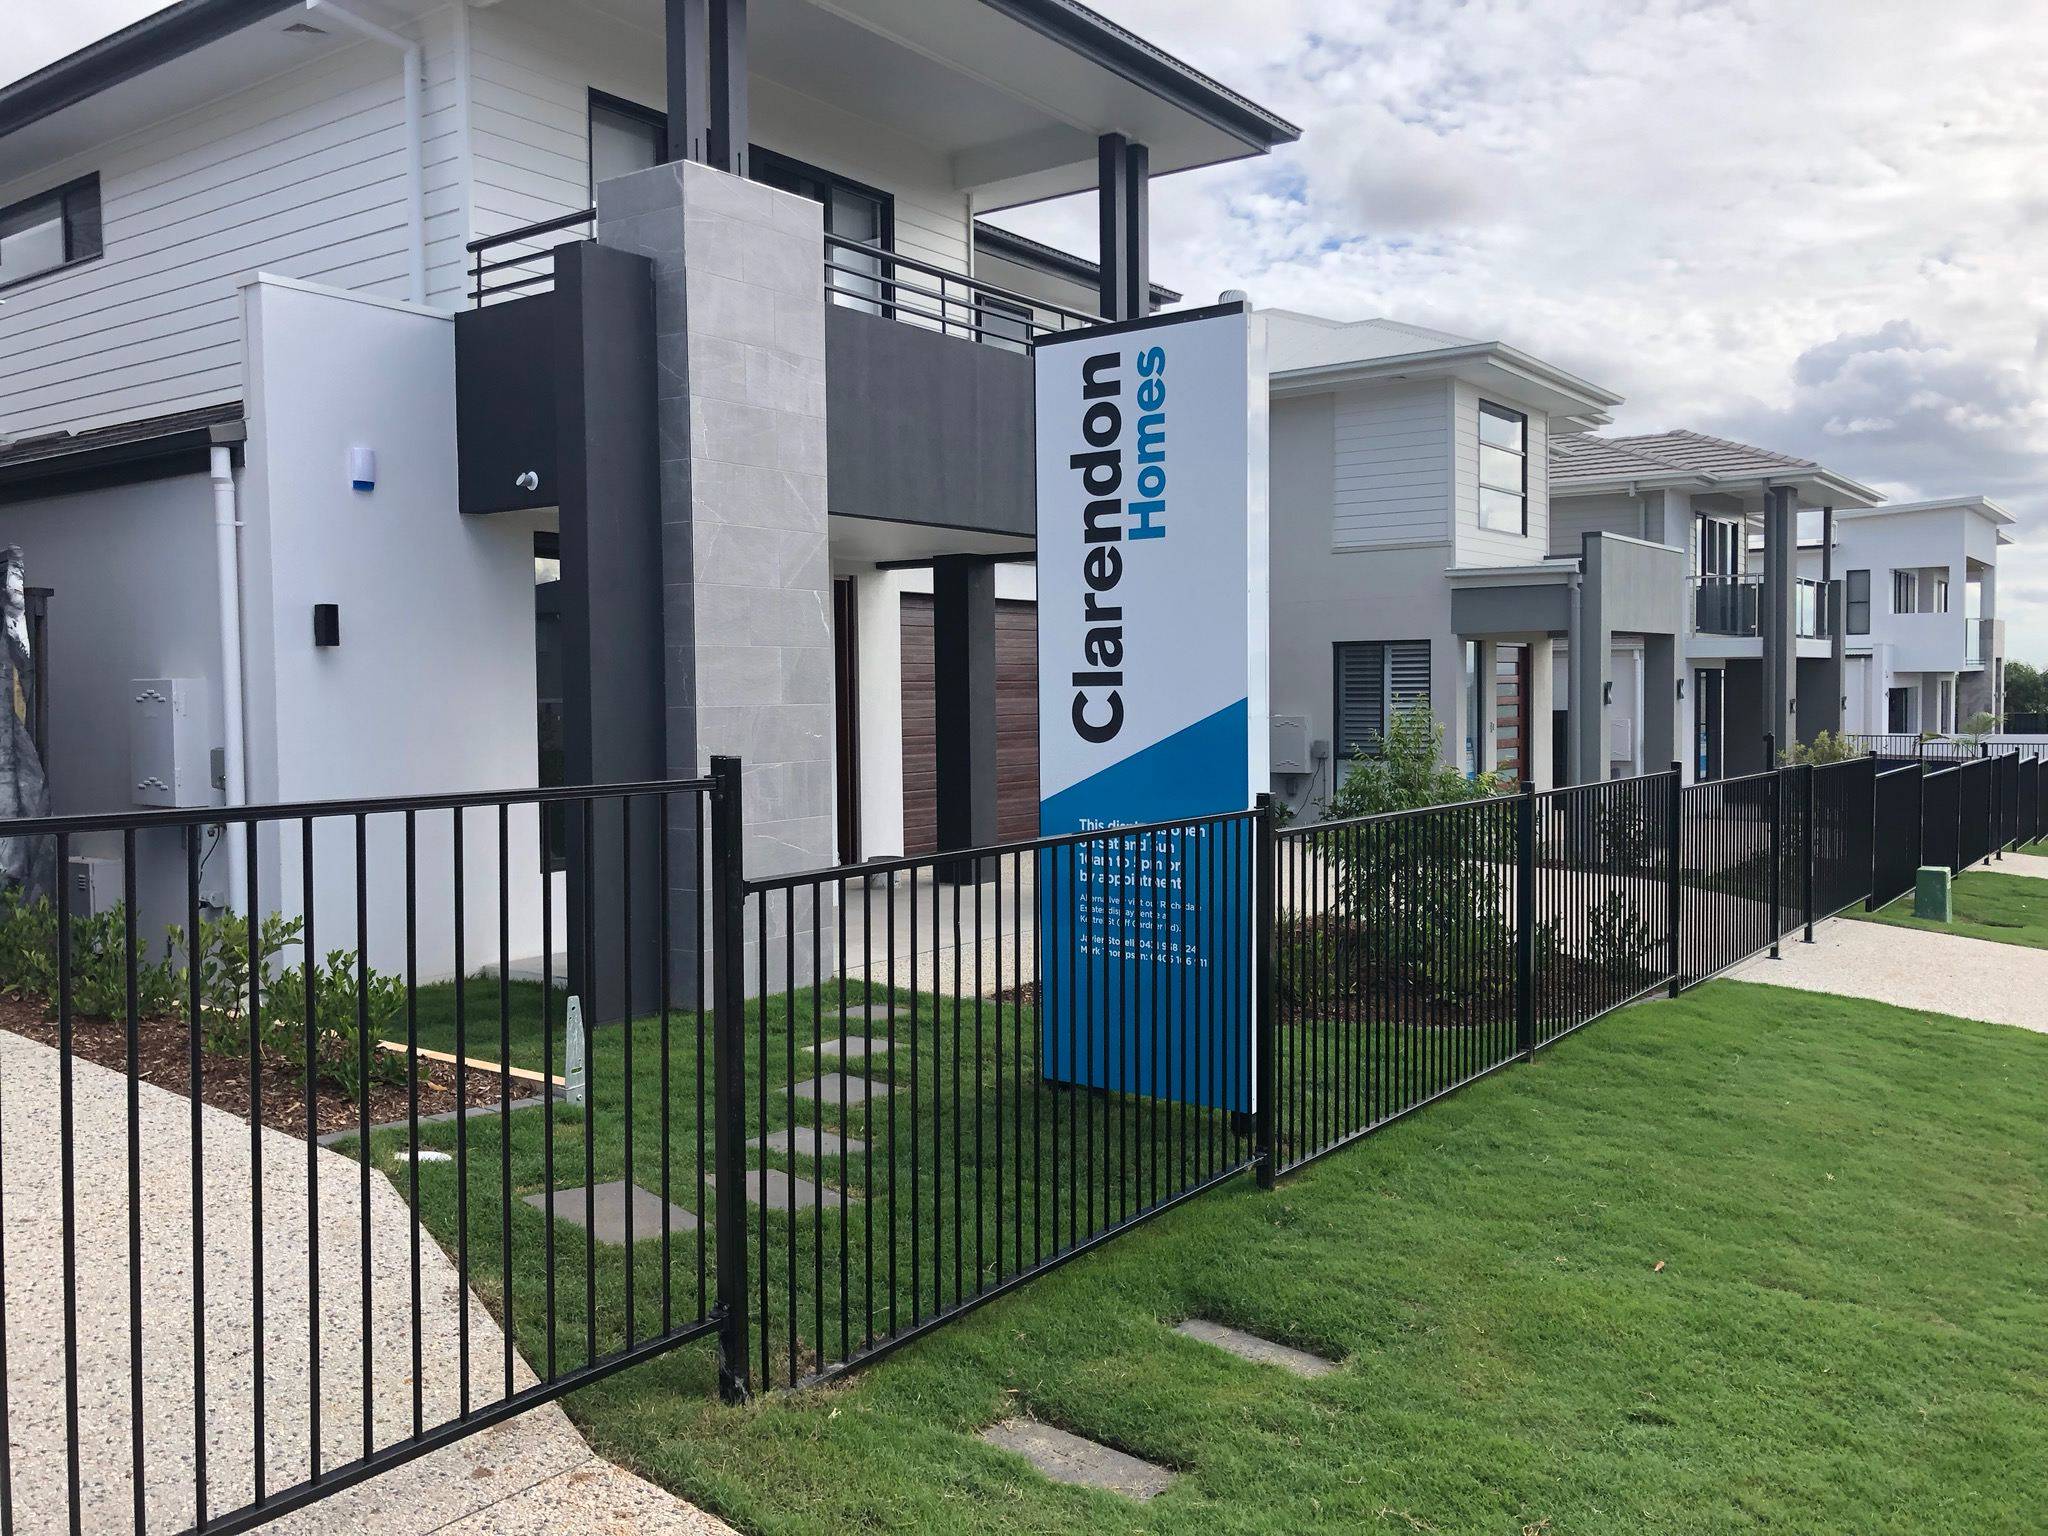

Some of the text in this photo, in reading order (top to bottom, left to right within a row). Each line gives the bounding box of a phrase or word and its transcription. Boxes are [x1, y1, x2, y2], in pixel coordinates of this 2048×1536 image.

[1128, 346, 1167, 541] Homes
[1070, 351, 1125, 744] Clarendon
[1079, 818, 1105, 831] This
